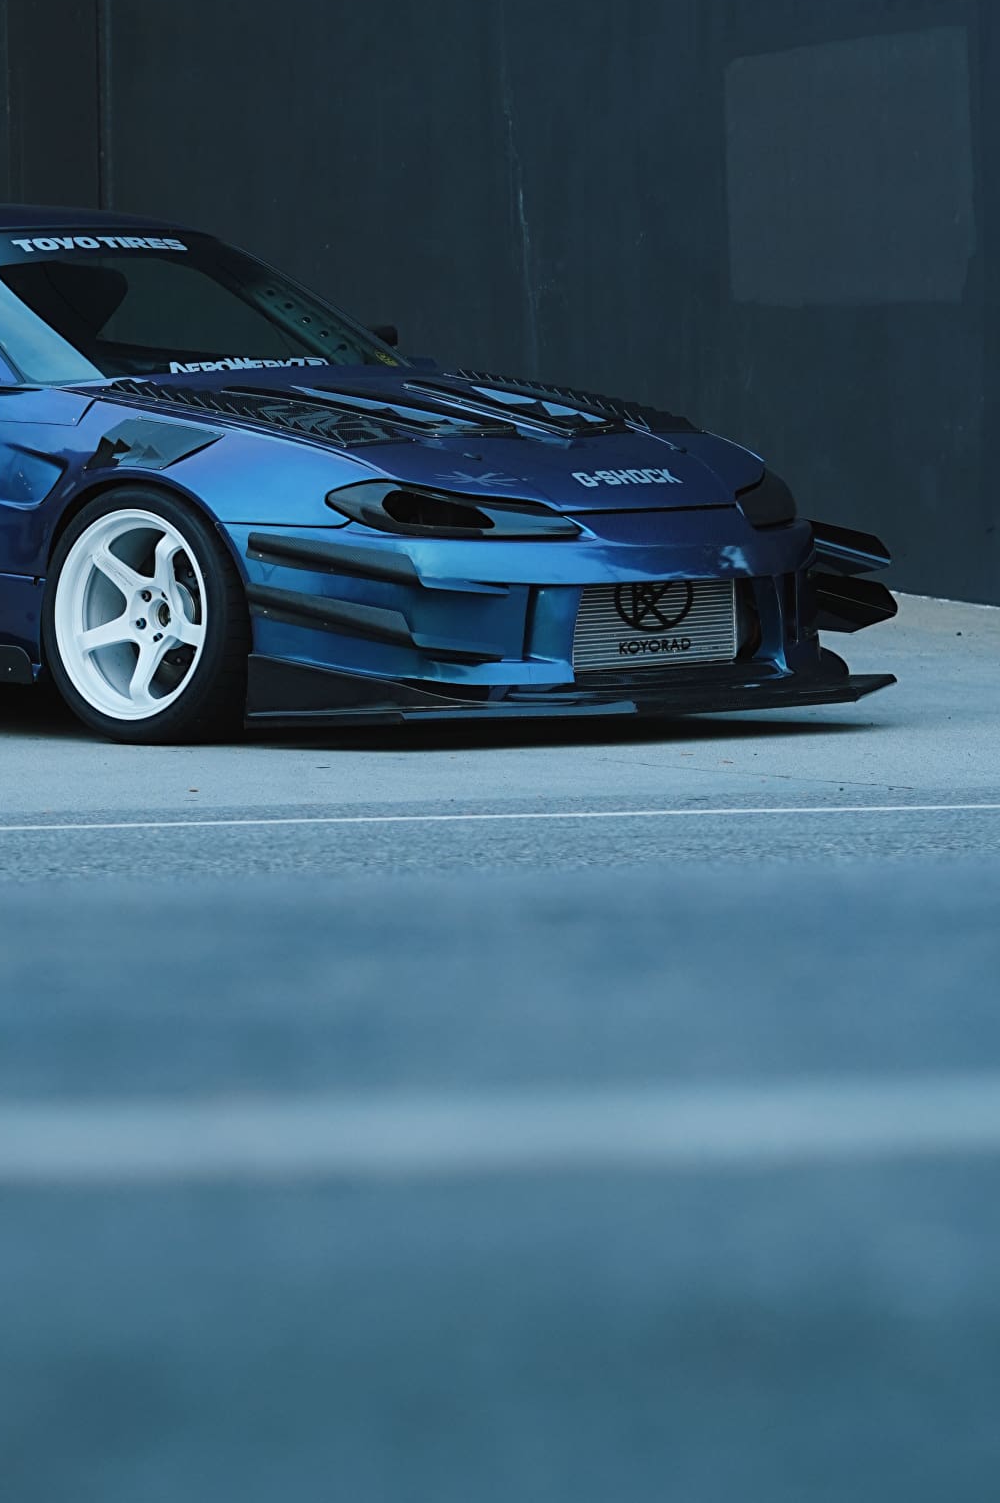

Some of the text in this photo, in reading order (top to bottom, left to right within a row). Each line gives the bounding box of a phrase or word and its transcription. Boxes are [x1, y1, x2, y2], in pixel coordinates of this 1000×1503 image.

[11, 236, 188, 253] TOYO TIRES
[571, 468, 683, 488] G-SHOCK
[618, 637, 692, 655] KOYORAD
